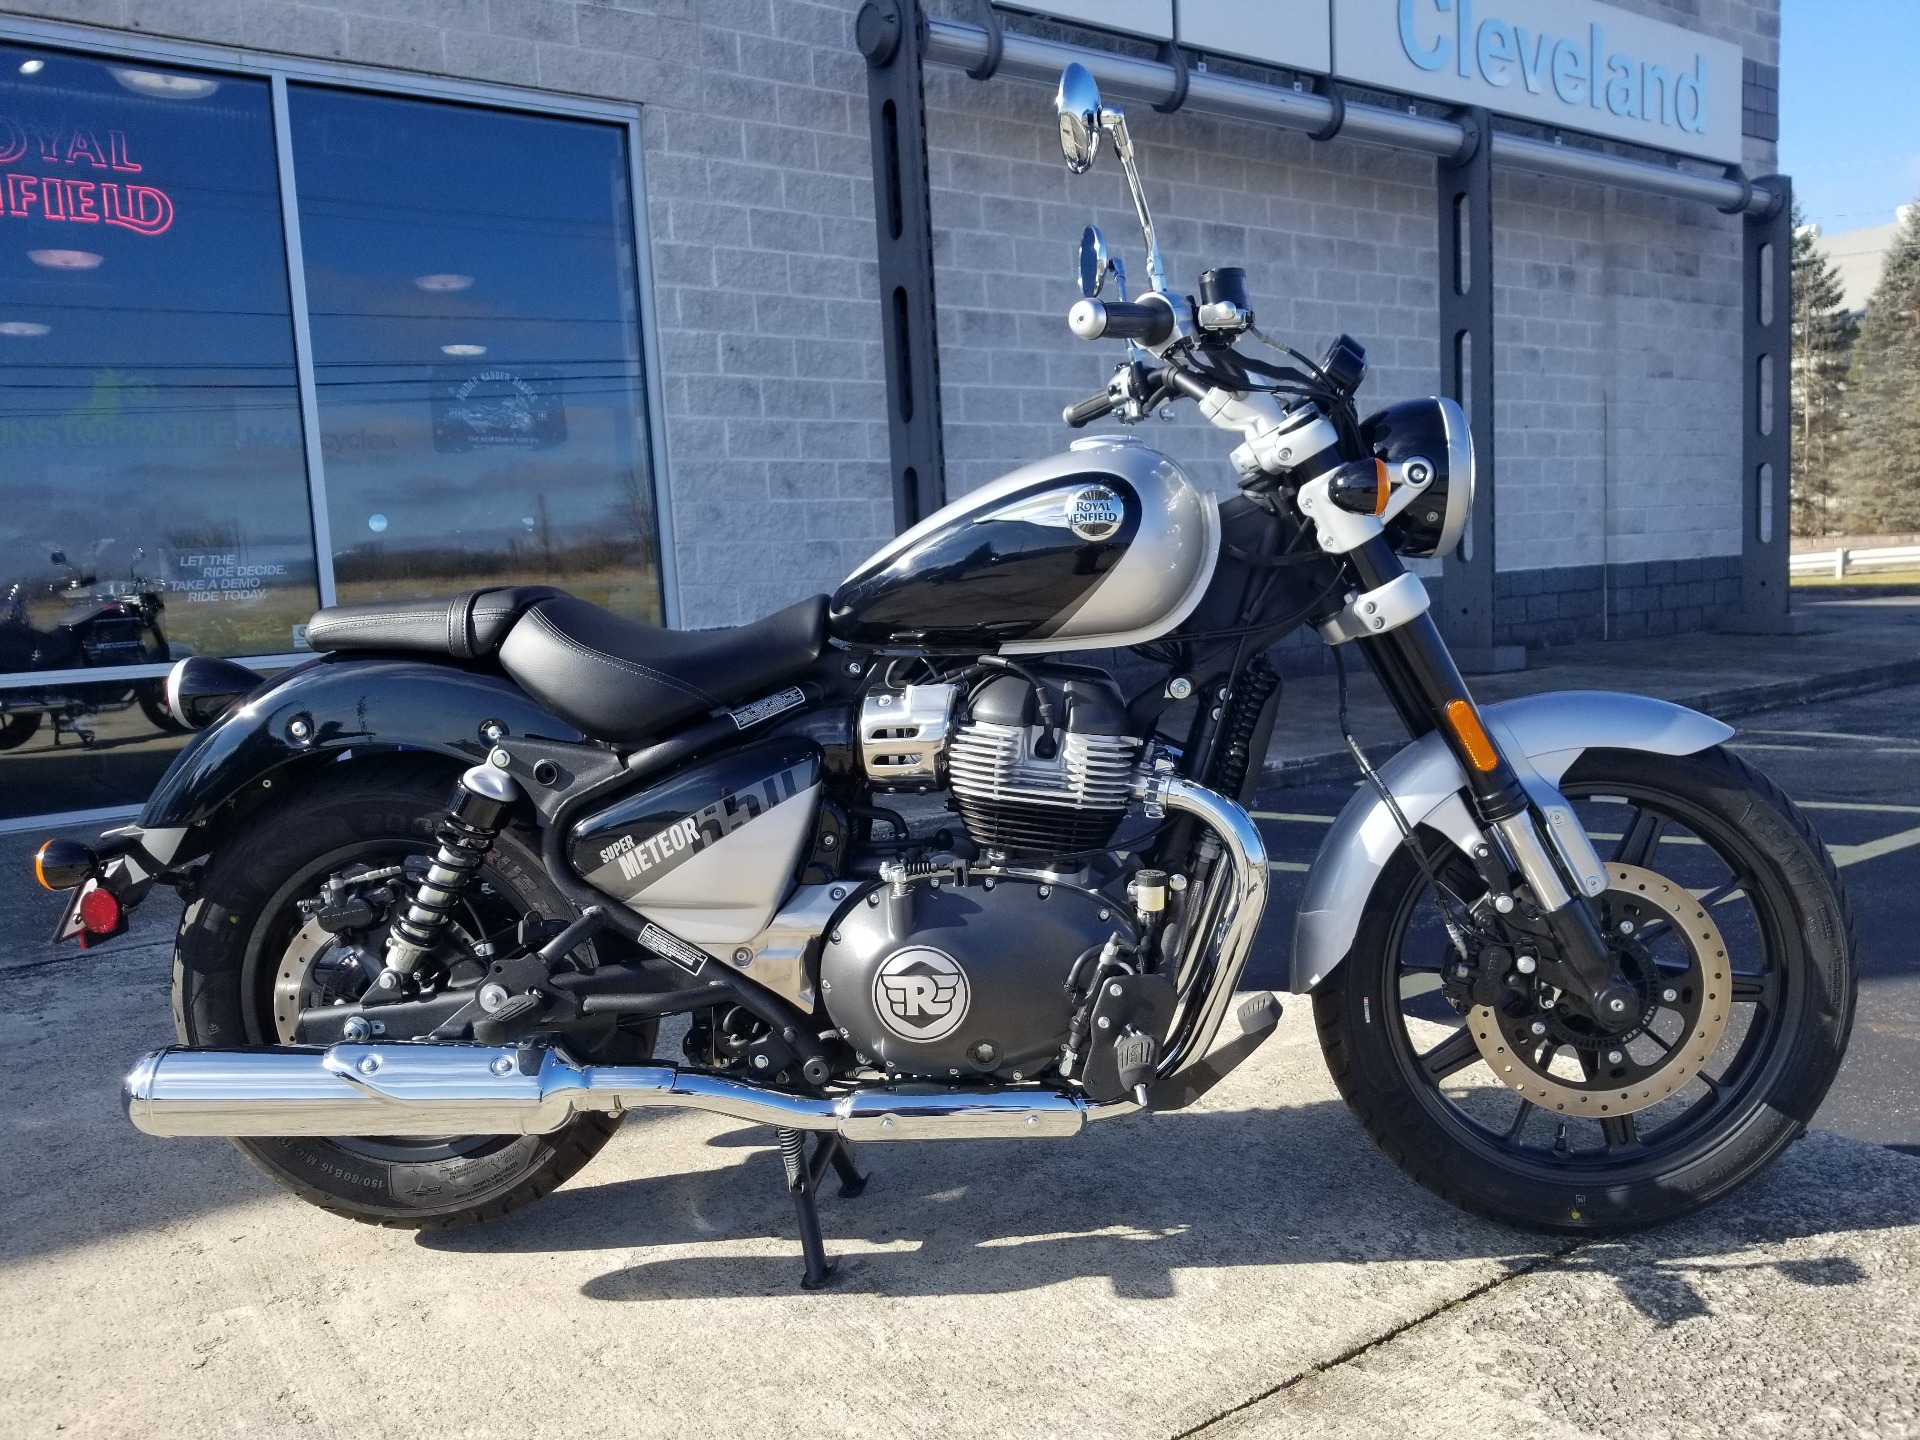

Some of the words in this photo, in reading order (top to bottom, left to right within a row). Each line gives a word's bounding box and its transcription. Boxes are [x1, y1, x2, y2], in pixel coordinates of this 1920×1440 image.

[1397, 0, 1708, 134] Cleveland
[0, 173, 174, 236] FIELD
[1076, 501, 1112, 512] ROYAL
[1073, 512, 1118, 523] ENFIELD
[180, 555, 205, 567] LET
[208, 554, 235, 565] THE
[203, 567, 234, 578] RIDE
[237, 564, 288, 577] DECIDE.
[170, 581, 205, 592] TAKE
[207, 579, 218, 589] A
[221, 578, 260, 589] DEMO
[188, 591, 219, 603] RIDE
[223, 588, 267, 601] TODAY.
[600, 834, 635, 864] SUPER
[618, 817, 700, 881] METEOR
[295, 1148, 318, 1166] M/C
[321, 1162, 384, 1189] 150/80B16
